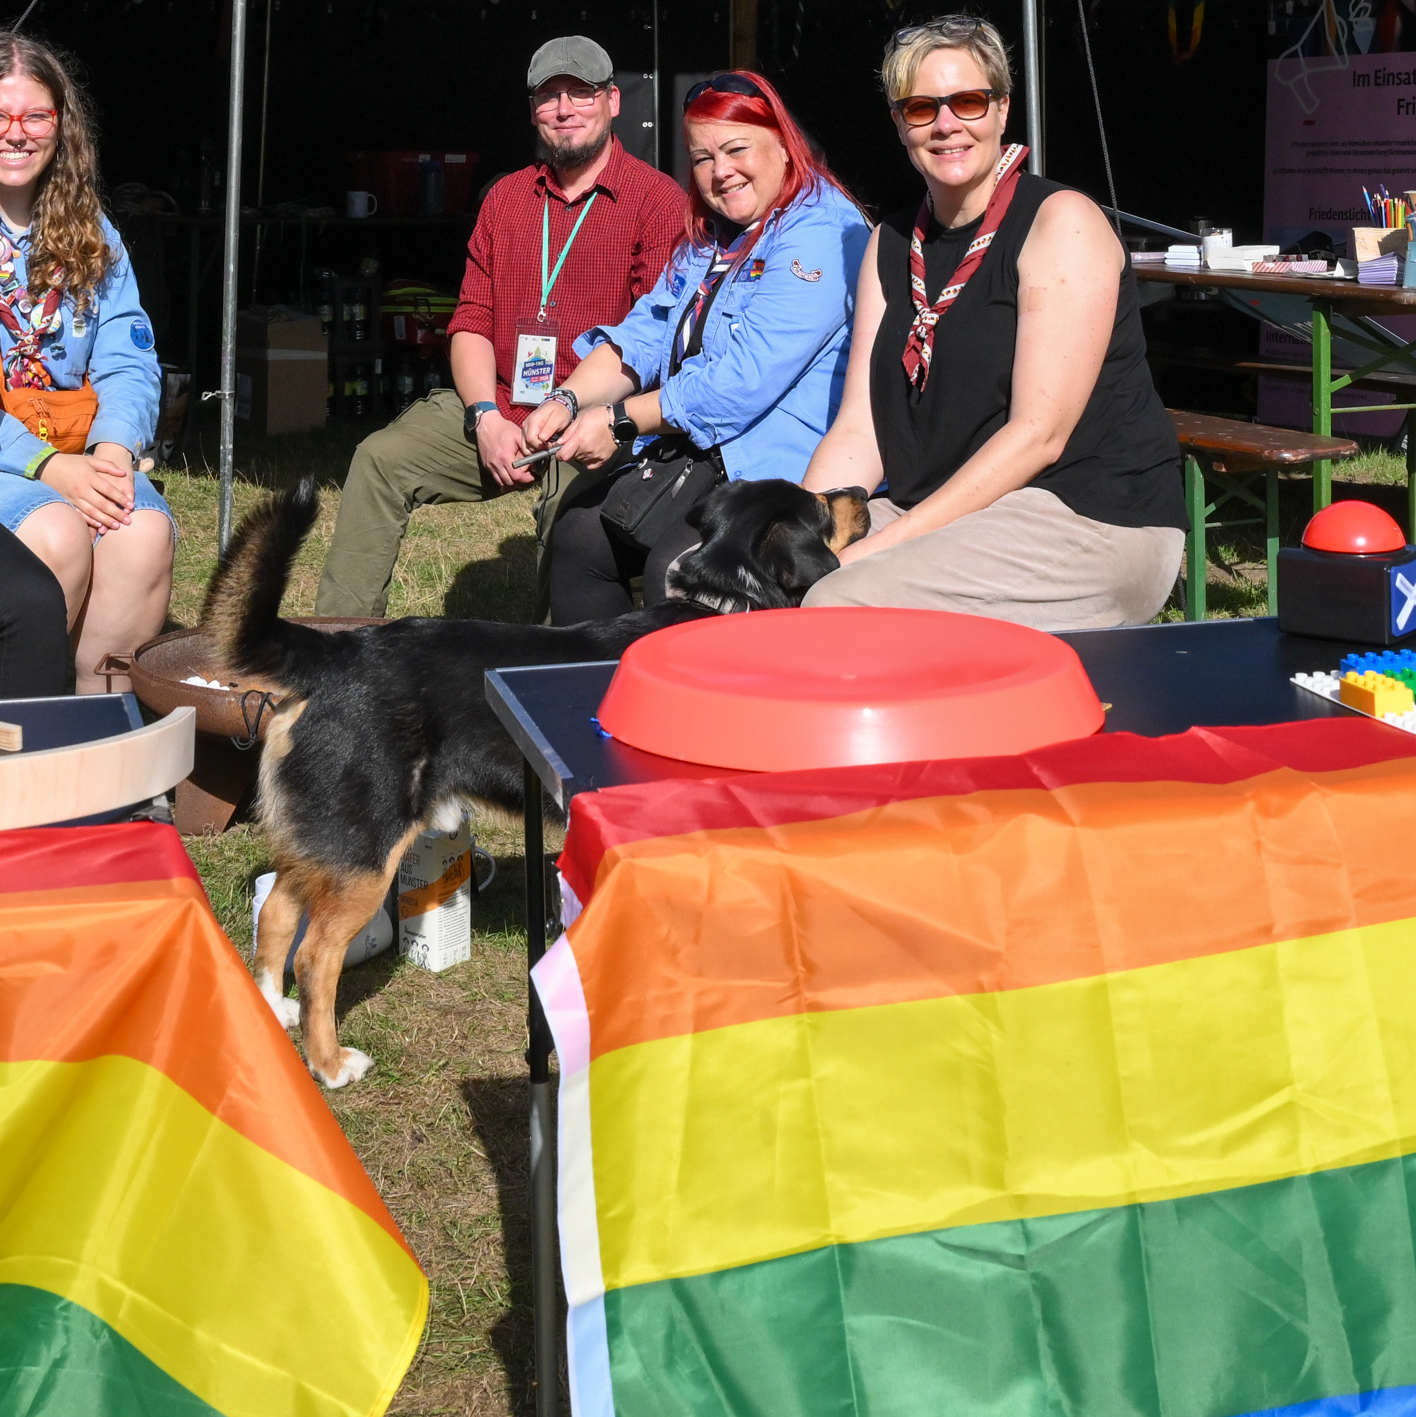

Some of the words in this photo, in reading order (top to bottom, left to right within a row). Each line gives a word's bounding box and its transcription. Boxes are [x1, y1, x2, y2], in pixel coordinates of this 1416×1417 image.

[1352, 70, 1370, 87] Im
[1309, 207, 1372, 221] Friedenslicht
[523, 367, 551, 376] MÜNSTER
[400, 862, 413, 875] AUS
